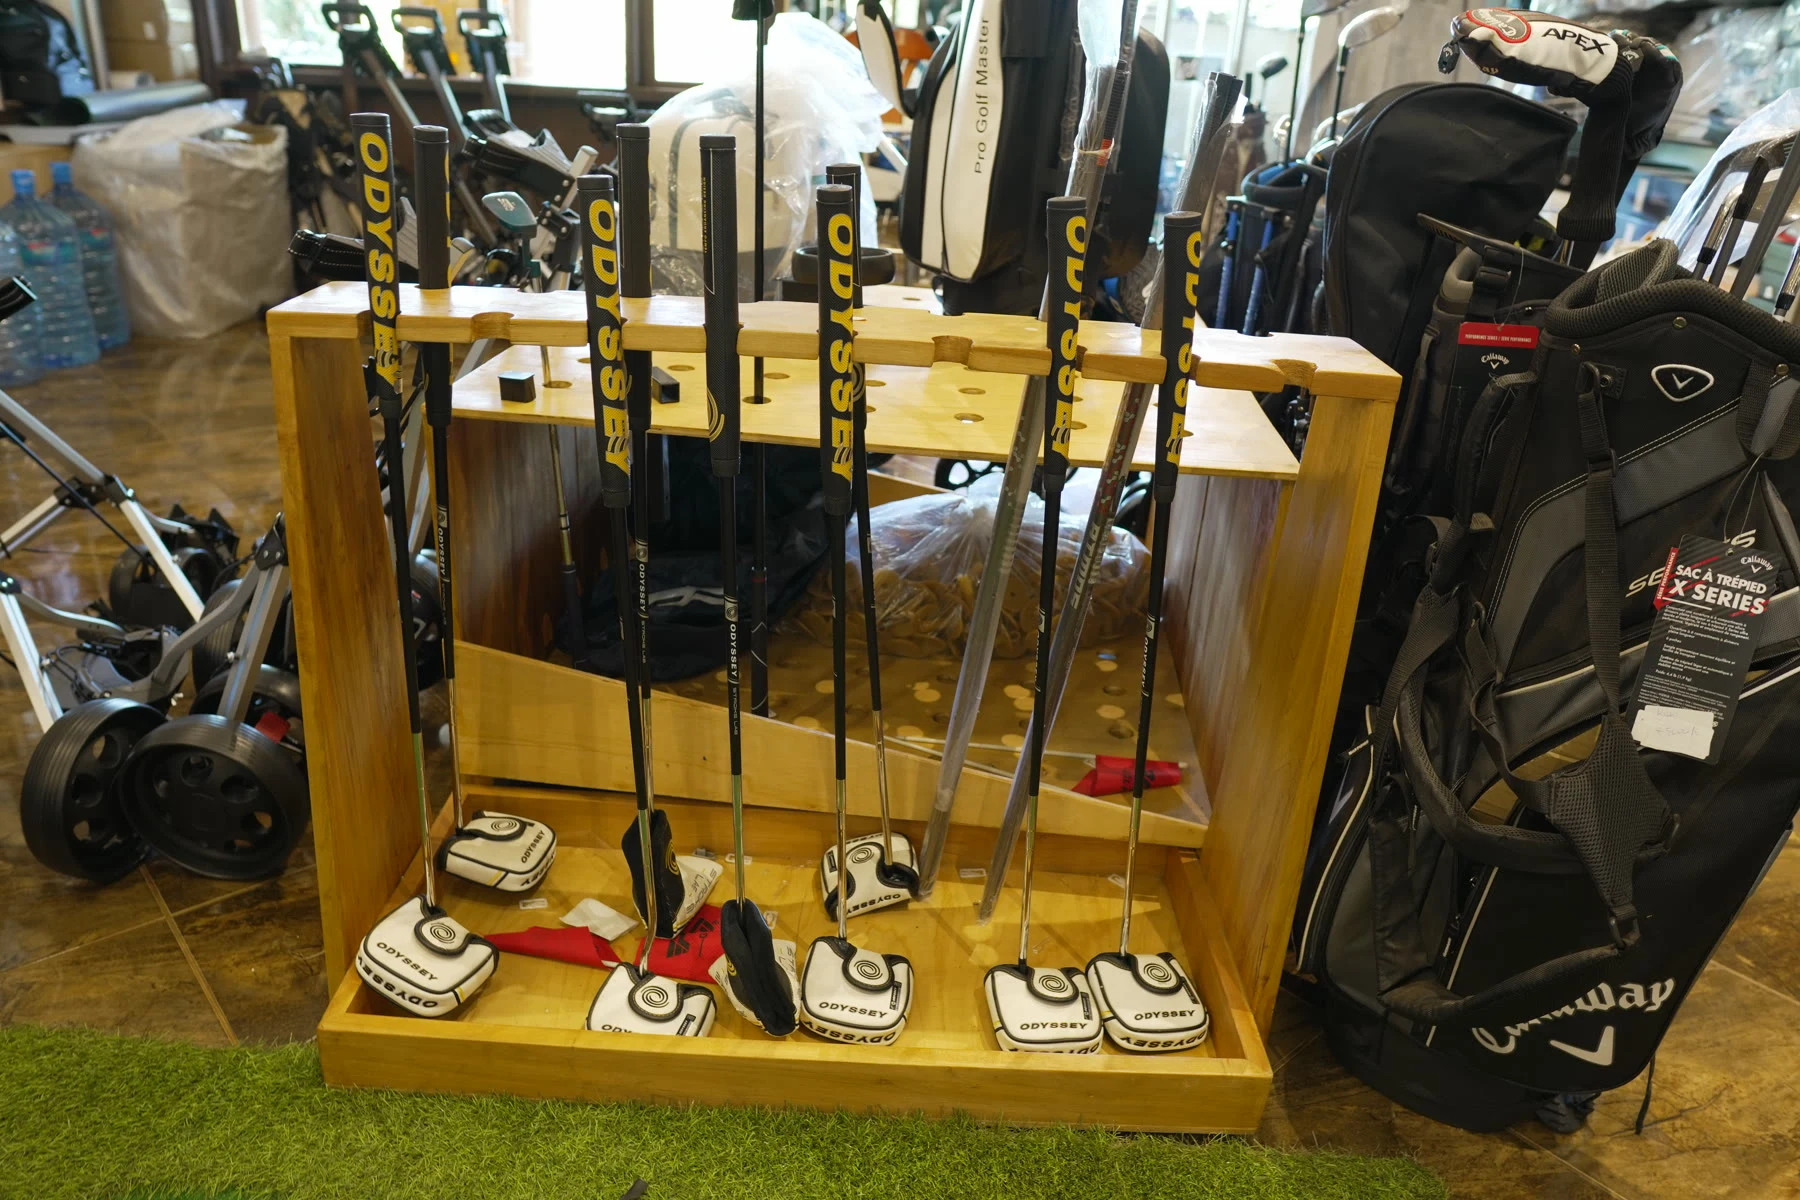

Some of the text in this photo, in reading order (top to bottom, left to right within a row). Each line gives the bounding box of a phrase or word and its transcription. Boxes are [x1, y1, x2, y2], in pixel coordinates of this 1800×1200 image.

[1542, 27, 1612, 55] APEX
[974, 19, 989, 174] Pro Golf Master
[360, 132, 402, 388] ODYSSEY
[589, 199, 630, 476] ODYSSEY
[828, 213, 853, 483] ODYSSEY
[438, 528, 447, 576] ODYSSEY
[1740, 555, 1774, 571] Callaway
[638, 563, 647, 612] ODYSSEY
[1668, 579, 1766, 615] X SERIES
[1675, 564, 1767, 595] SAC À TRÉPIED
[730, 624, 739, 678] ODYSSEY
[521, 829, 546, 864] ODYSSEY
[376, 942, 438, 981] ODYSSEY
[358, 956, 438, 1008] ODYSSEY
[819, 1001, 888, 1018] ODYSSEY
[1020, 1022, 1088, 1031] ODYSSEY
[1134, 1009, 1196, 1021] ODYSSEY
[804, 1020, 897, 1044] ODYSSEY
[1120, 1029, 1207, 1049] ODYSSEY
